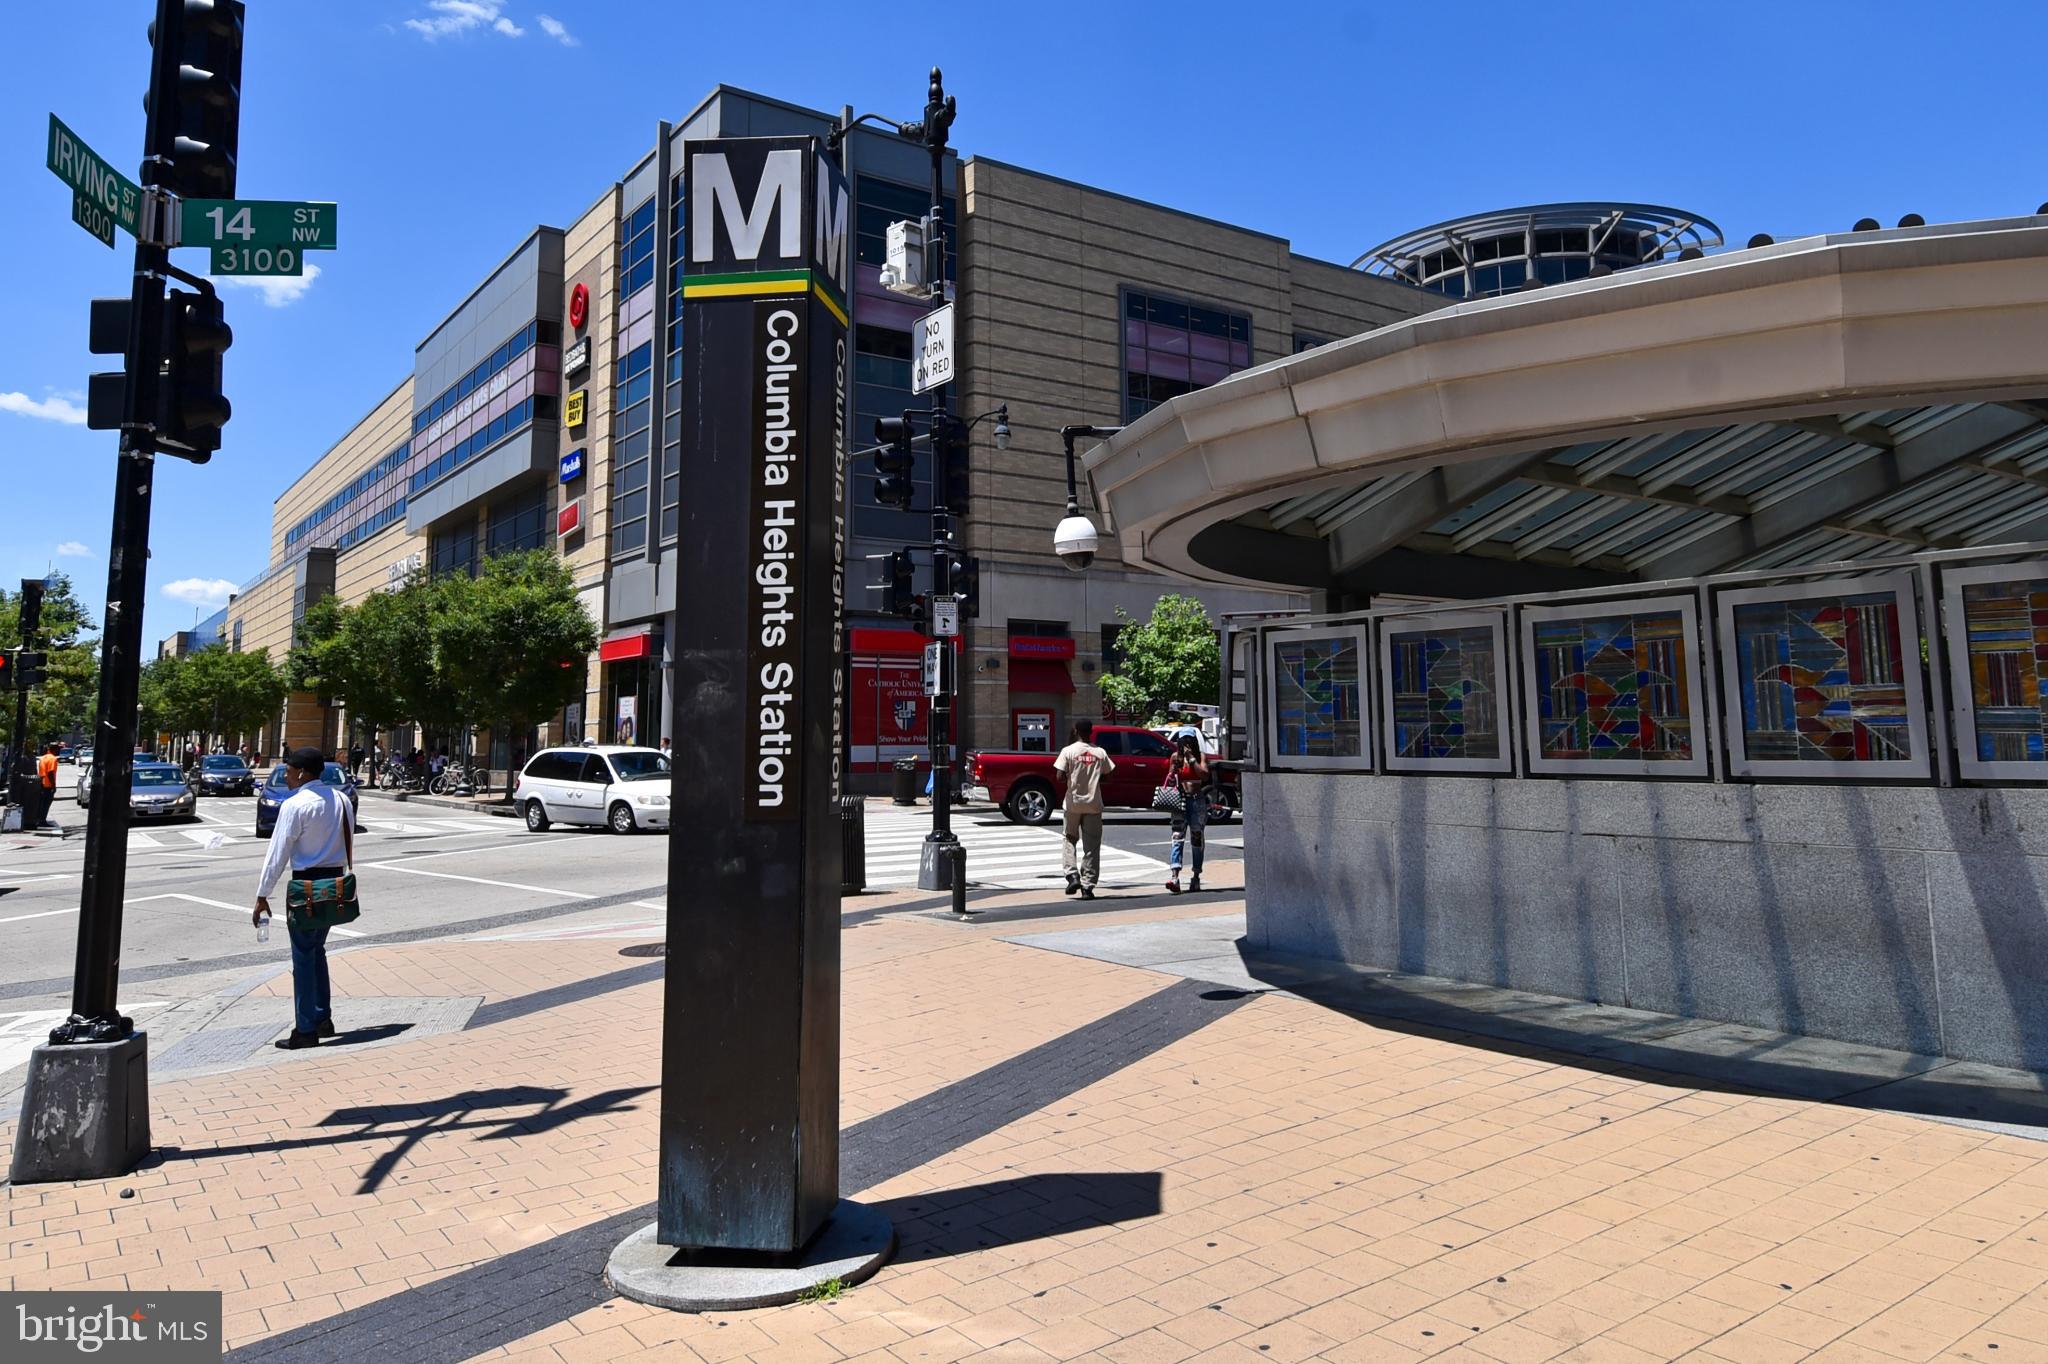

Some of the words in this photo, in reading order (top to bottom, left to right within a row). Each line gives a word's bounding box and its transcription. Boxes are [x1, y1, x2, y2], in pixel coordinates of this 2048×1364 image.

[54, 127, 119, 215] IRVING
[123, 187, 136, 207] ST
[77, 196, 111, 241] 1300
[121, 204, 135, 225] NW
[206, 207, 256, 240] 14
[294, 208, 320, 223] ST
[692, 150, 801, 262] M
[815, 153, 848, 293] M
[292, 228, 321, 242] NW
[220, 249, 295, 272] 3100
[921, 339, 944, 360] TURN
[926, 321, 940, 338] NO
[917, 366, 929, 382] ON
[932, 357, 950, 376] RED
[568, 396, 582, 410] BEST
[568, 409, 581, 422] BUY
[764, 309, 799, 486] Columbia
[834, 338, 846, 502] Columbia
[756, 500, 796, 648] Heights
[832, 515, 844, 653] Heights
[758, 662, 794, 807] Station
[831, 667, 843, 802] Station
